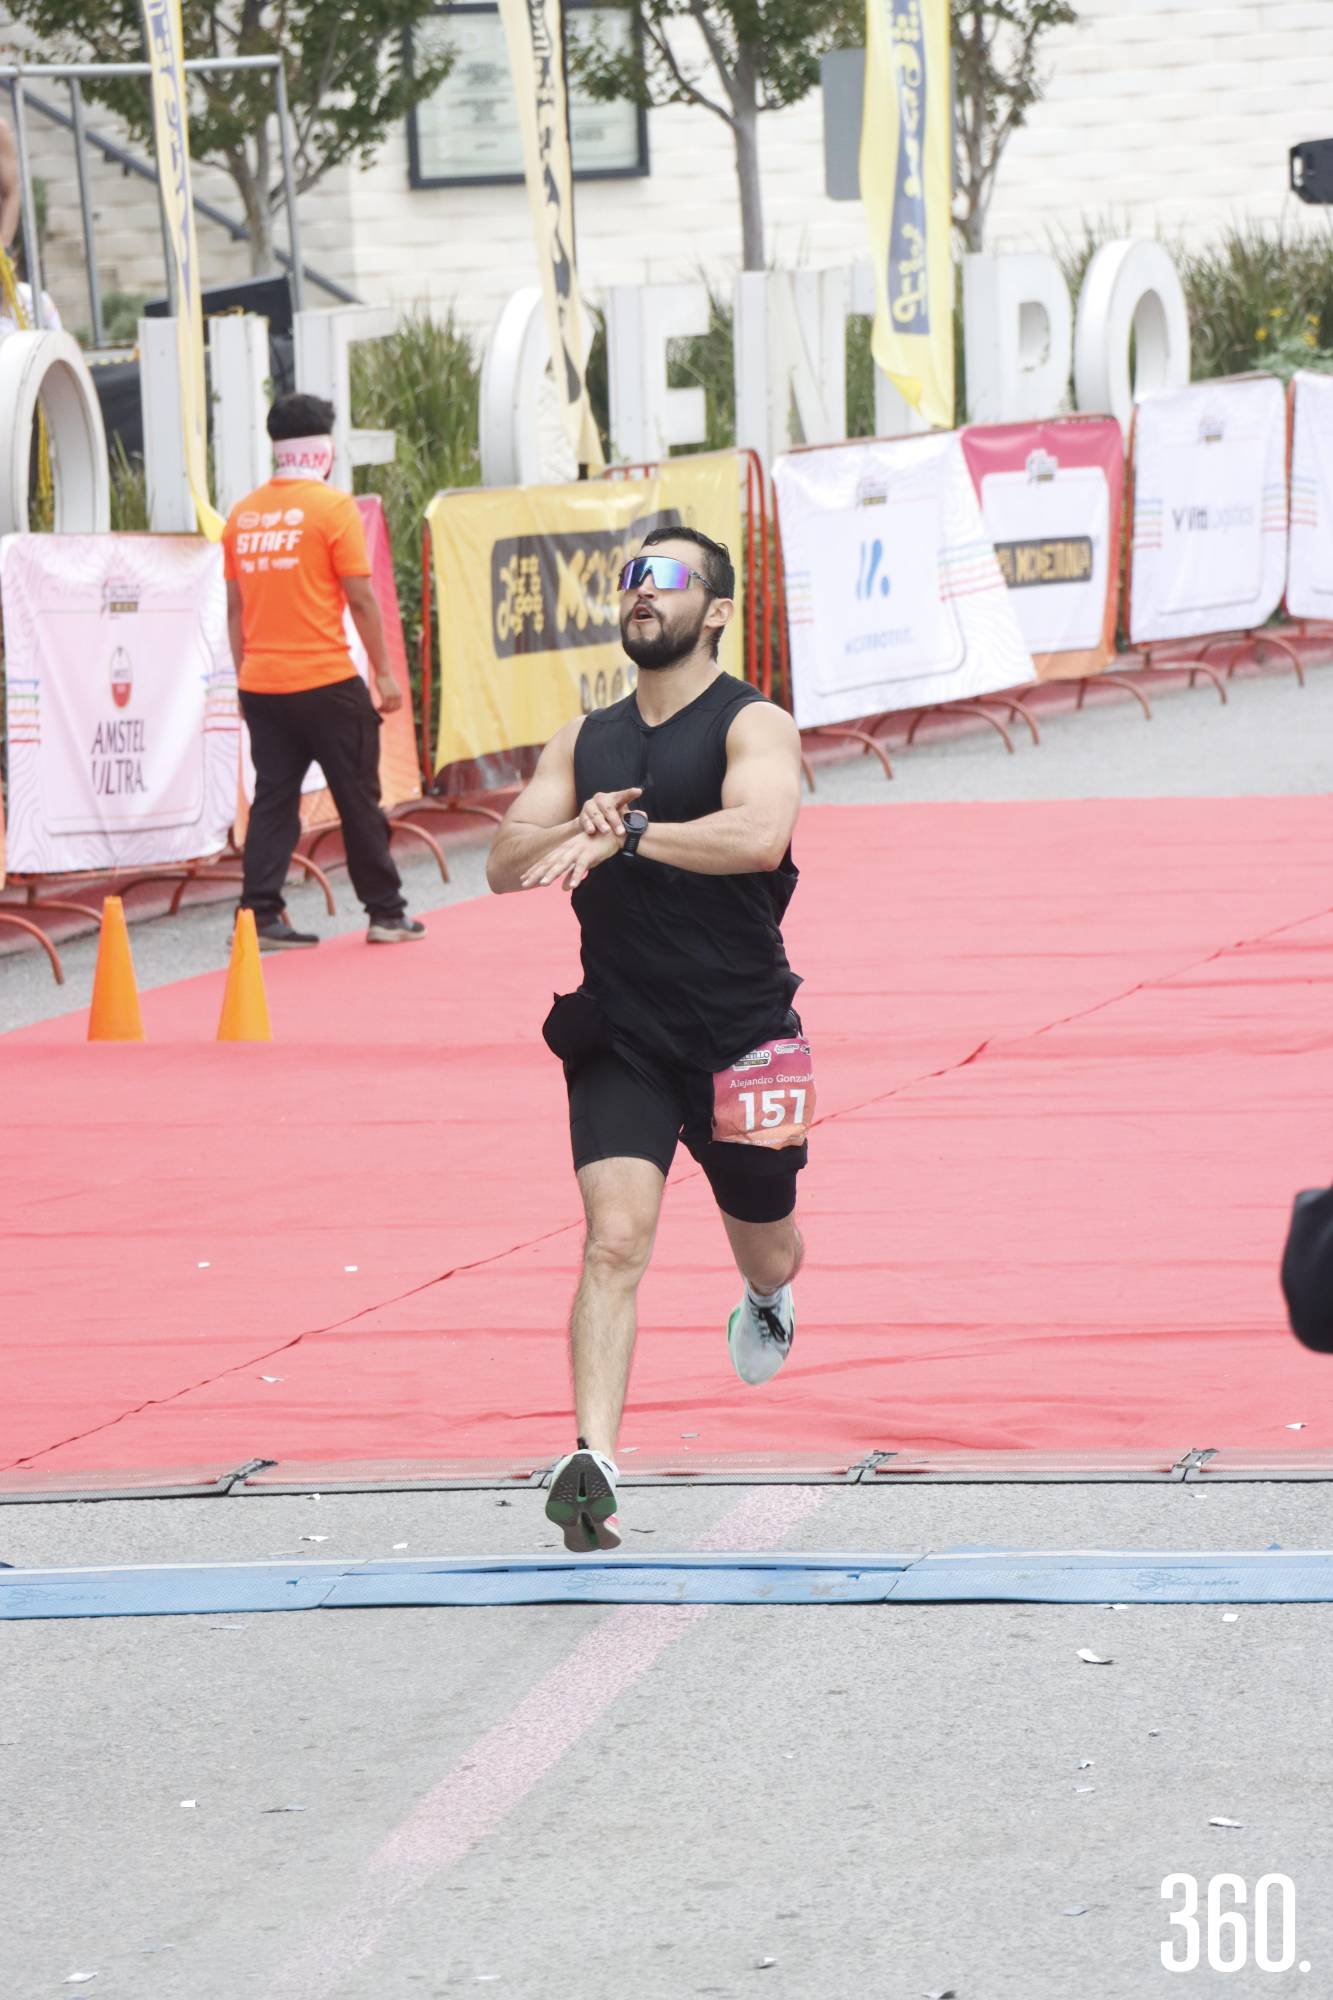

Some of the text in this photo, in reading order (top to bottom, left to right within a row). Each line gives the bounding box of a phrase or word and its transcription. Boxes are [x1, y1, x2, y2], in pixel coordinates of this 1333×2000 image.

[237, 529, 303, 554] STAFF
[91, 720, 145, 754] AMSTEL
[730, 1076, 773, 1089] Alejandro
[739, 1089, 806, 1131] 157
